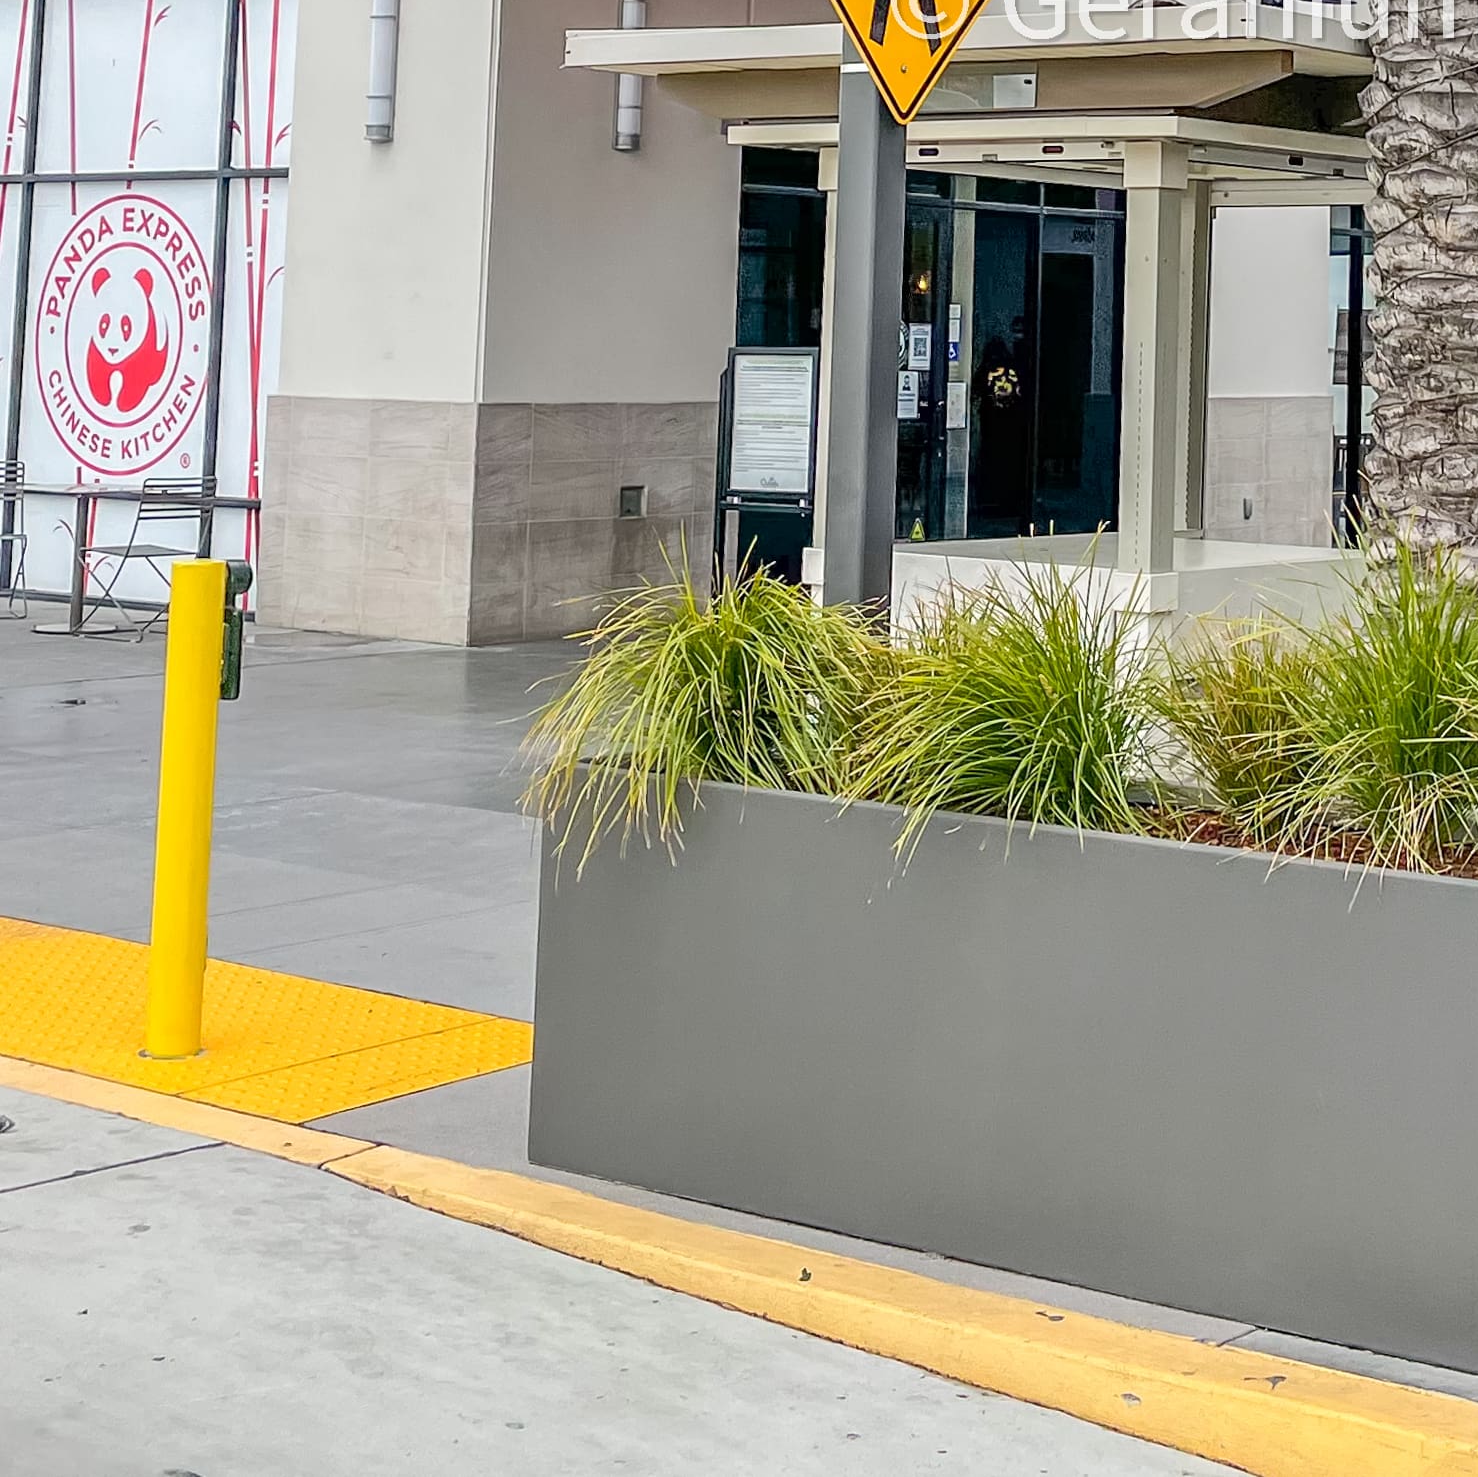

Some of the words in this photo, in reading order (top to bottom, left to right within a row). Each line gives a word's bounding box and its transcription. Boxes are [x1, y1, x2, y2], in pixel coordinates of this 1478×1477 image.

[46, 215, 114, 318] PANDA
[122, 207, 205, 322] EXPRESS
[49, 369, 112, 459] CHINESE
[121, 374, 196, 460] KITCHEN
